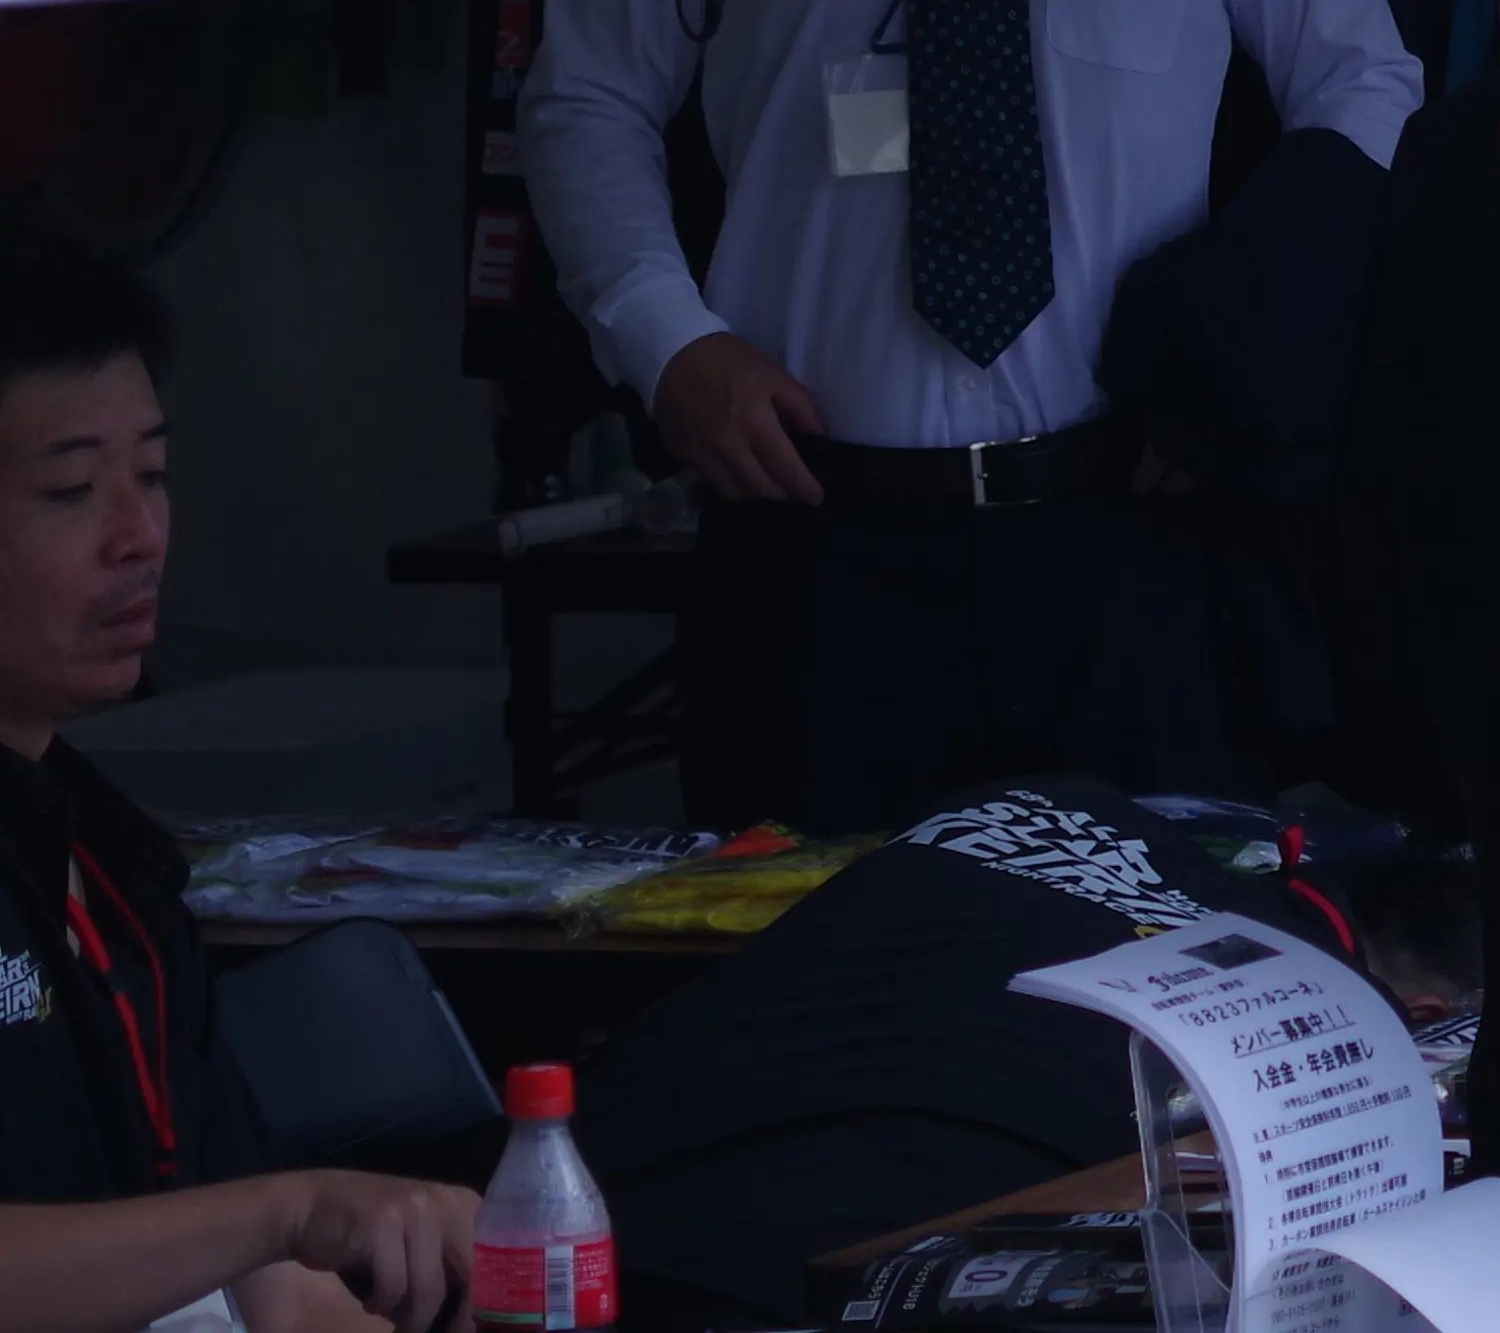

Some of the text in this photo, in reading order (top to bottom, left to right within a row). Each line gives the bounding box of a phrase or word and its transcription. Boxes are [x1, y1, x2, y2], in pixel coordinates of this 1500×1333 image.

[1252, 1037, 1375, 1093] 入会金・年会費無し
